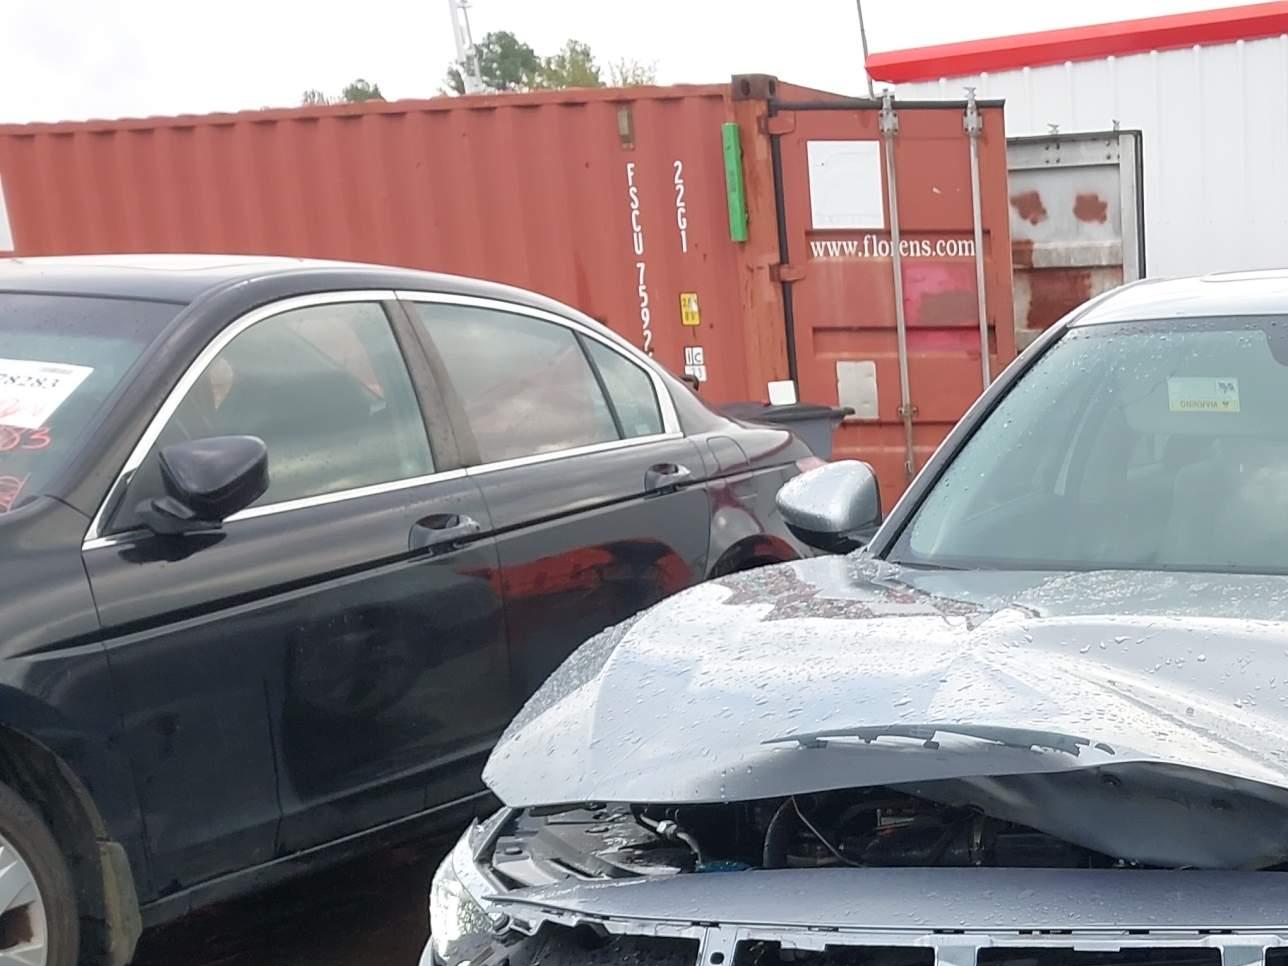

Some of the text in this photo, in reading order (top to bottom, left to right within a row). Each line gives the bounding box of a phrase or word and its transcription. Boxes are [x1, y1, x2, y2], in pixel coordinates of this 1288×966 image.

[626, 163, 654, 358] FSCU 7592
[673, 160, 687, 253] 22G1
